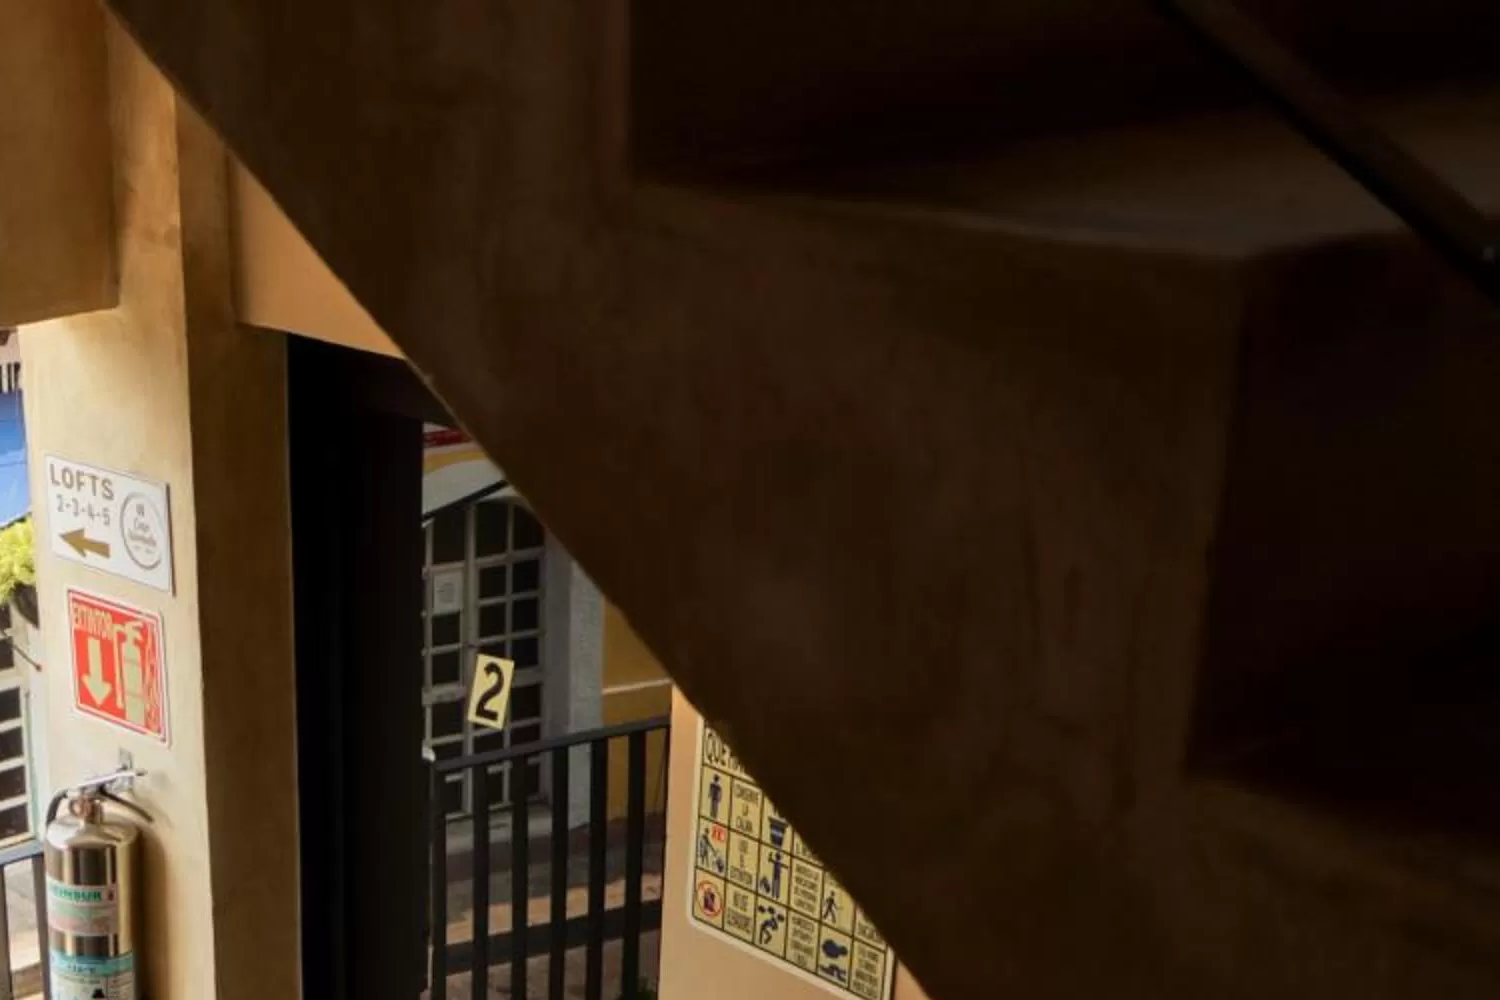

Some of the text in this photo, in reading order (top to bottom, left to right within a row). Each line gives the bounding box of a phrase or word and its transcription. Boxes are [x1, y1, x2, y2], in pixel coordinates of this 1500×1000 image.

[49, 463, 115, 501] LOFTS
[56, 493, 110, 526] 2-3-4-5
[475, 662, 504, 721] 2
